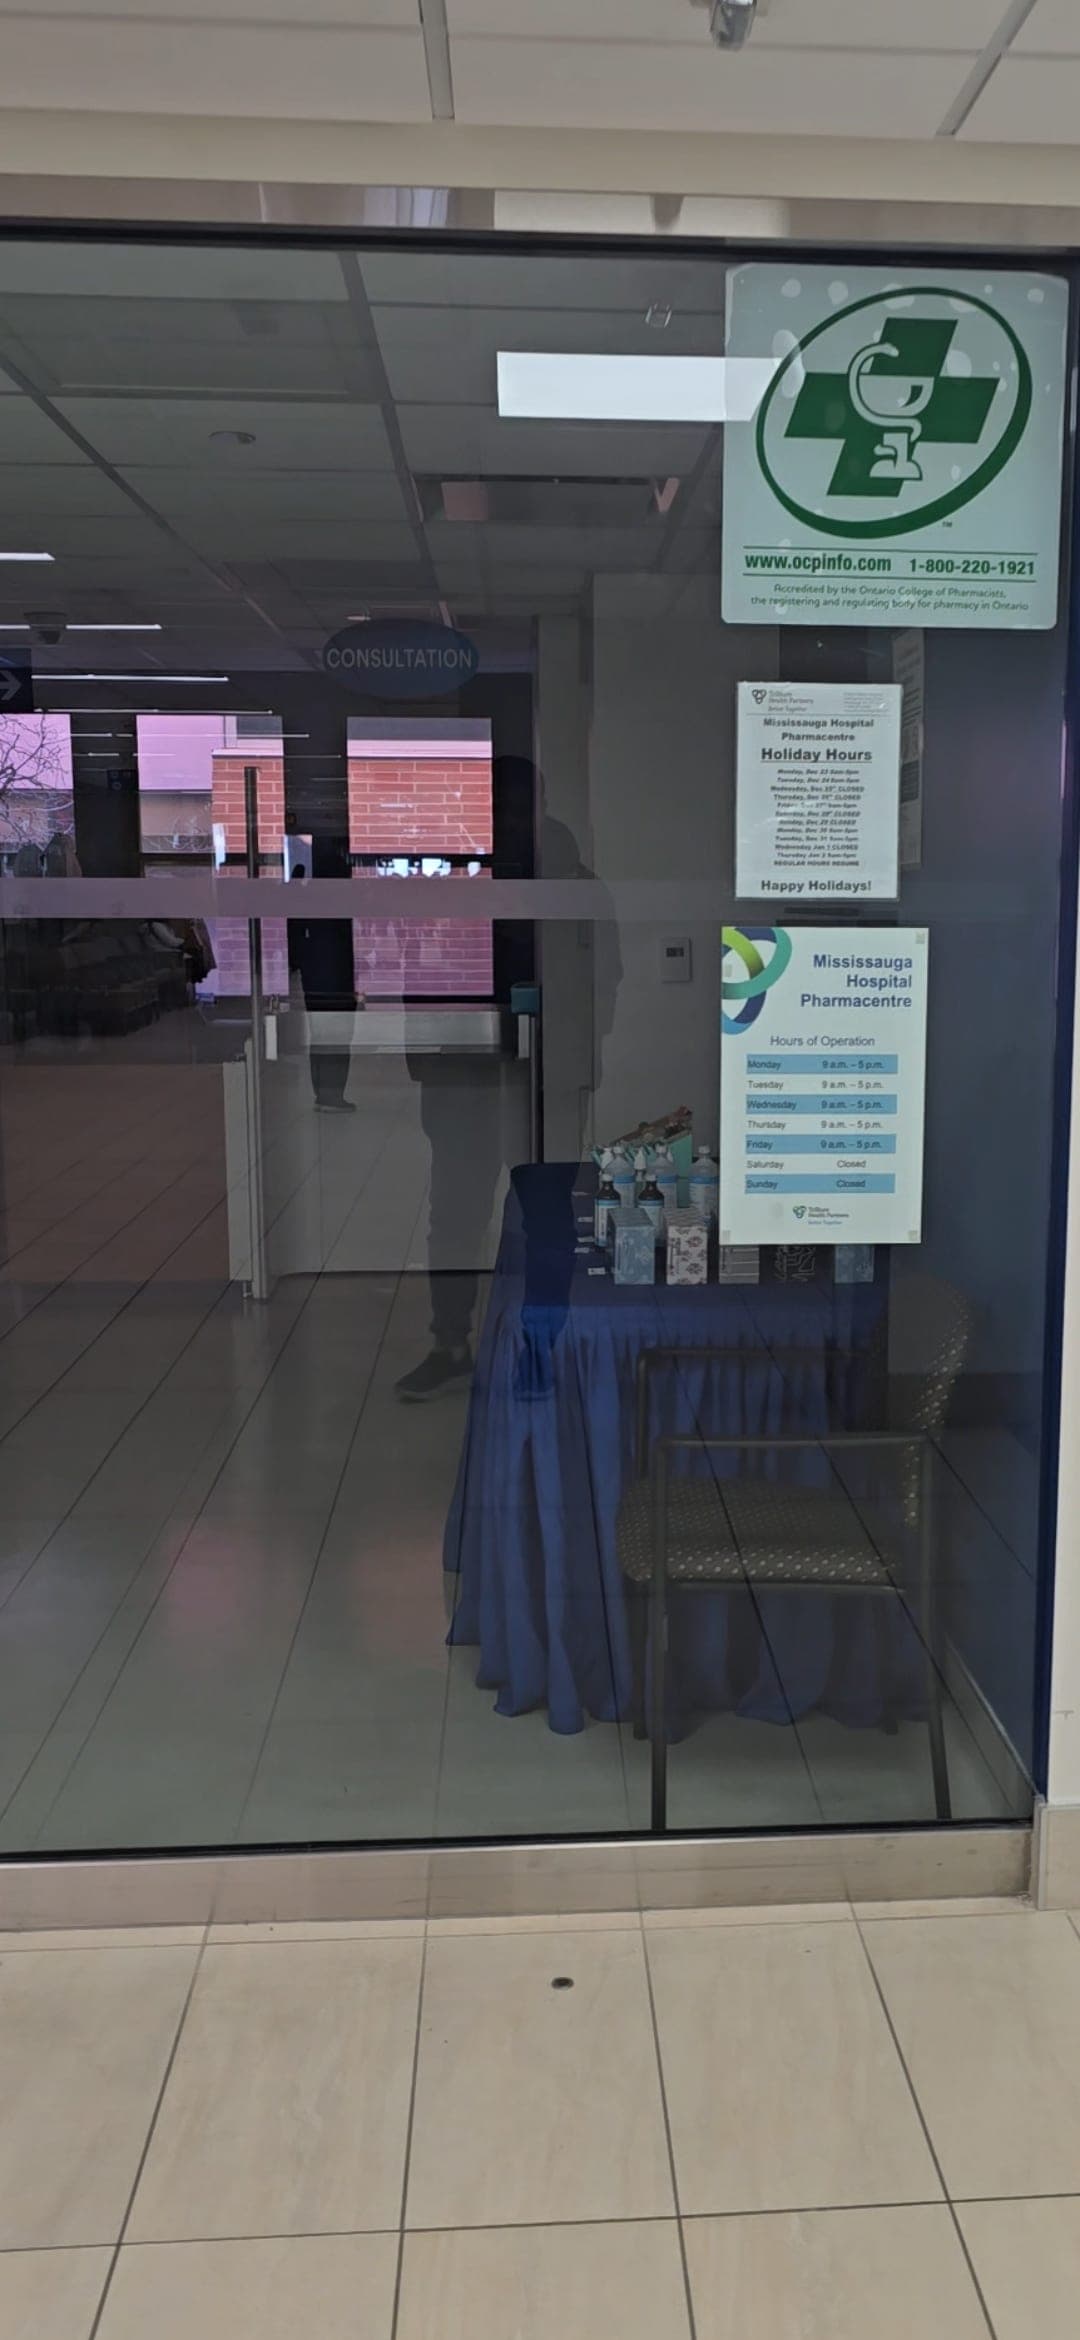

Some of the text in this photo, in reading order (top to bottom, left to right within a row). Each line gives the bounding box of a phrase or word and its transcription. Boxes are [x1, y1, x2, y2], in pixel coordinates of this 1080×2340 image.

[745, 553, 1034, 576] www.ocpinfo.com 1-800-220-1921
[774, 584, 1006, 599] Accredited by the Ontario College of Pharmacists,
[751, 597, 1029, 612] the registering and regulating body for pharmacy in Ontario
[327, 649, 472, 668] CONSULTATION
[763, 719, 874, 729] Mississauga Hospital
[781, 732, 855, 741] Pharmacentre
[761, 748, 872, 763] Holiday Hours
[761, 880, 871, 893] Happy Holidays!
[813, 954, 913, 971] Mississauga
[847, 974, 912, 990] Hospital
[801, 993, 912, 1008] Pharmacentre
[770, 1036, 875, 1047] Hours of Operation
[747, 1060, 781, 1070] Monday
[822, 1061, 828, 1069] 9
[858, 1061, 864, 1069] 5
[748, 1081, 784, 1090] Tuesday
[822, 1081, 827, 1089] 9
[858, 1081, 863, 1089] 5
[747, 1100, 797, 1110] Wednesday
[821, 1101, 827, 1109] 9
[857, 1101, 863, 1109] 5
[747, 1121, 786, 1130] Thursday
[821, 1121, 826, 1129] 9
[857, 1121, 862, 1129] 5
[747, 1141, 773, 1150] Friday
[821, 1141, 826, 1149] 9
[857, 1141, 862, 1149] 5
[747, 1160, 866, 1169] Saturday Closed
[746, 1180, 866, 1189] Sunday Closed
